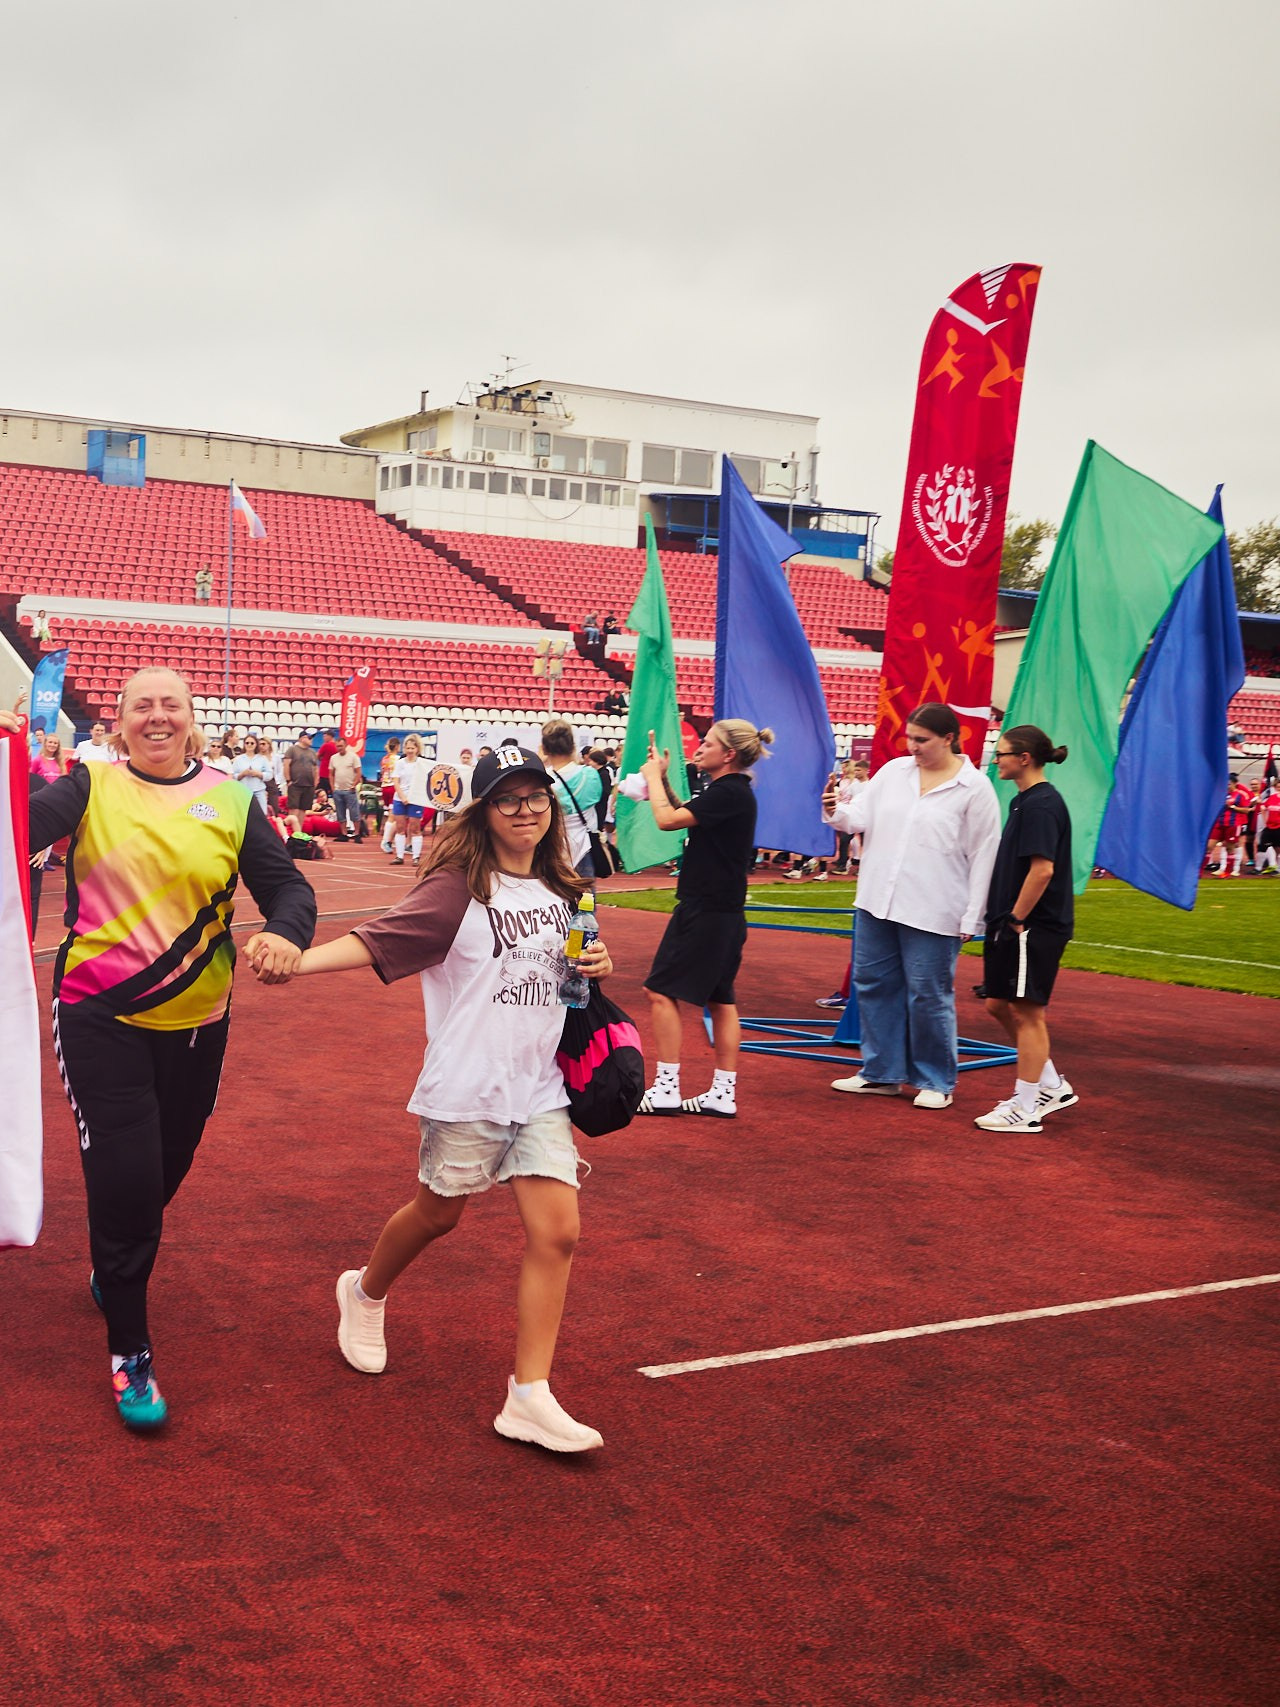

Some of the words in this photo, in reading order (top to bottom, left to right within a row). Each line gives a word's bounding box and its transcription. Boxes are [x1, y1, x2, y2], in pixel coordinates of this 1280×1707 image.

[344, 693, 358, 738] ОСНОВА
[496, 749, 524, 770] 10
[512, 951, 542, 962] BELIEVE
[493, 980, 552, 1006] POSITIVE
